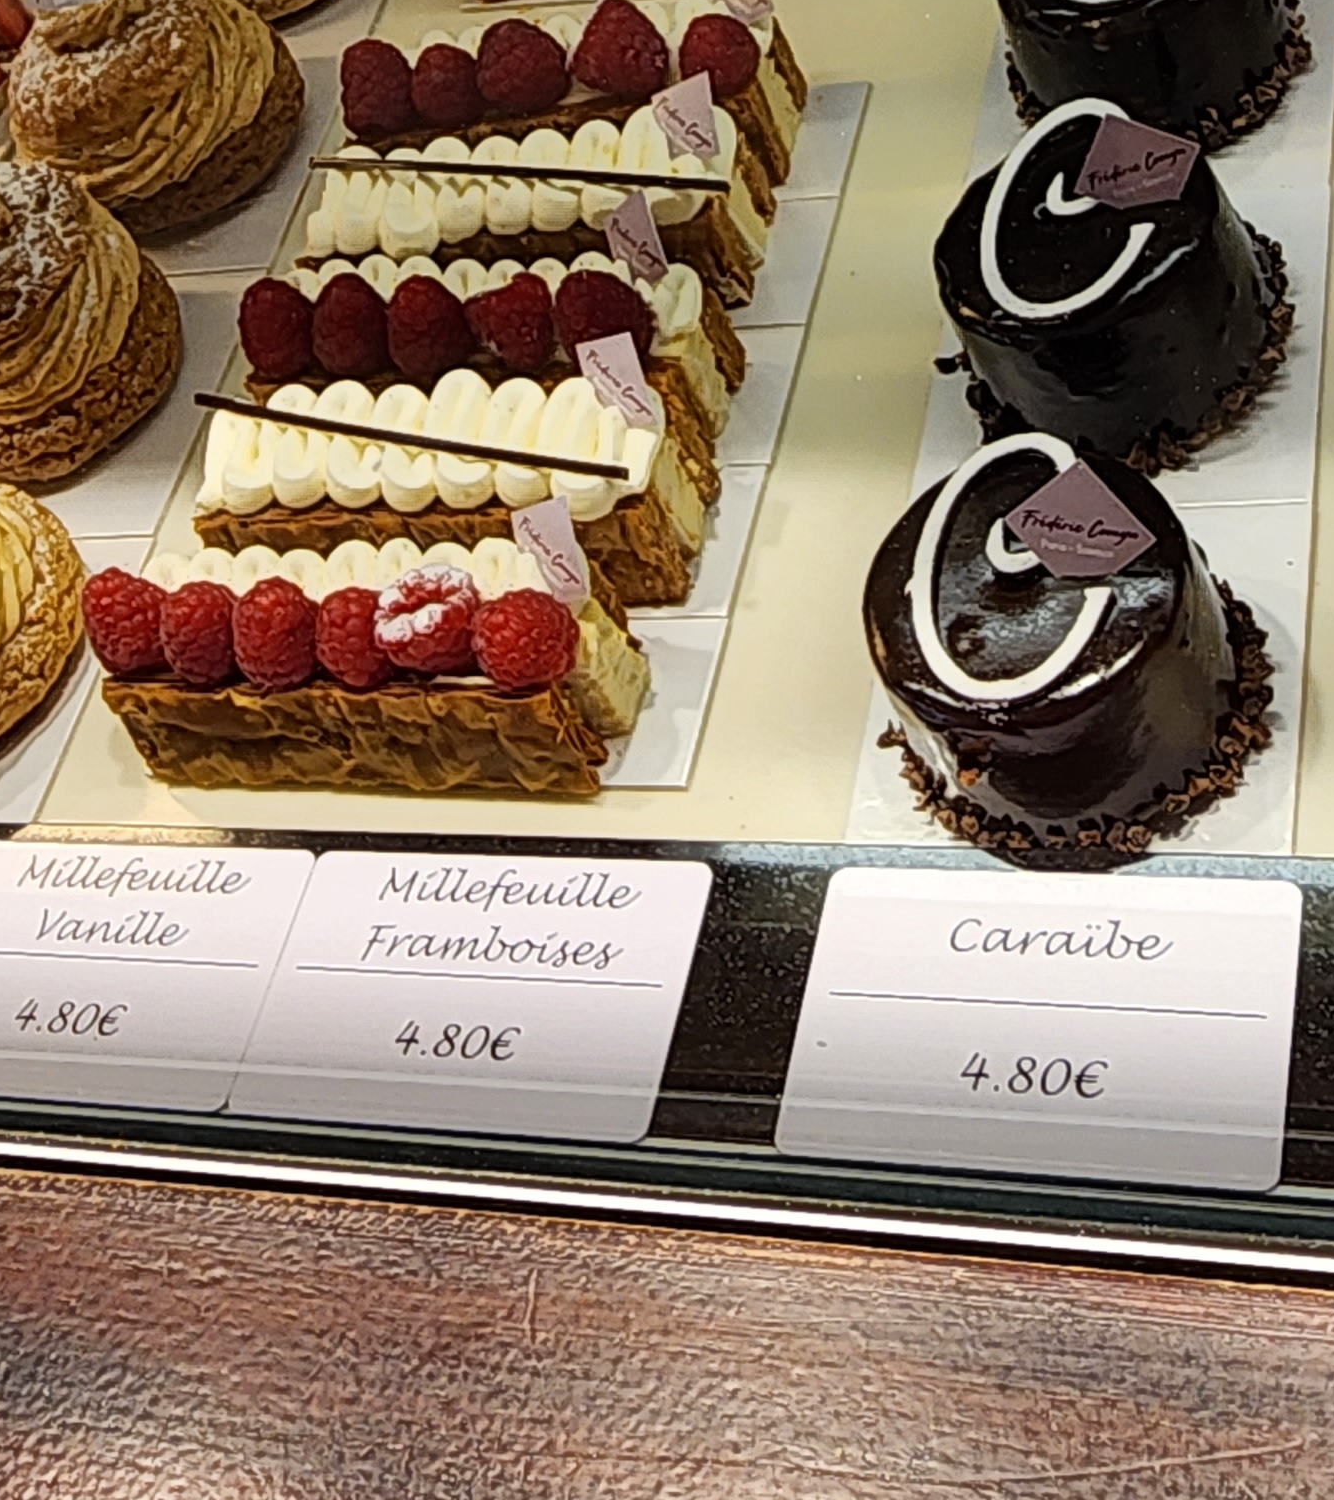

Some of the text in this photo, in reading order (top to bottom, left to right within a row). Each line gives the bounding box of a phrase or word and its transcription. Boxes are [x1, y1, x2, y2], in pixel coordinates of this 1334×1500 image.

[16, 853, 252, 898] Millefeuille
[378, 866, 643, 912] Millefeuille
[35, 907, 191, 948] Vanille
[360, 924, 625, 970] Framboises
[949, 917, 1175, 961] Caraïbe
[14, 997, 129, 1037] 4.80€
[394, 1019, 522, 1062] 4.80€
[959, 1051, 1110, 1099] 4.80€
